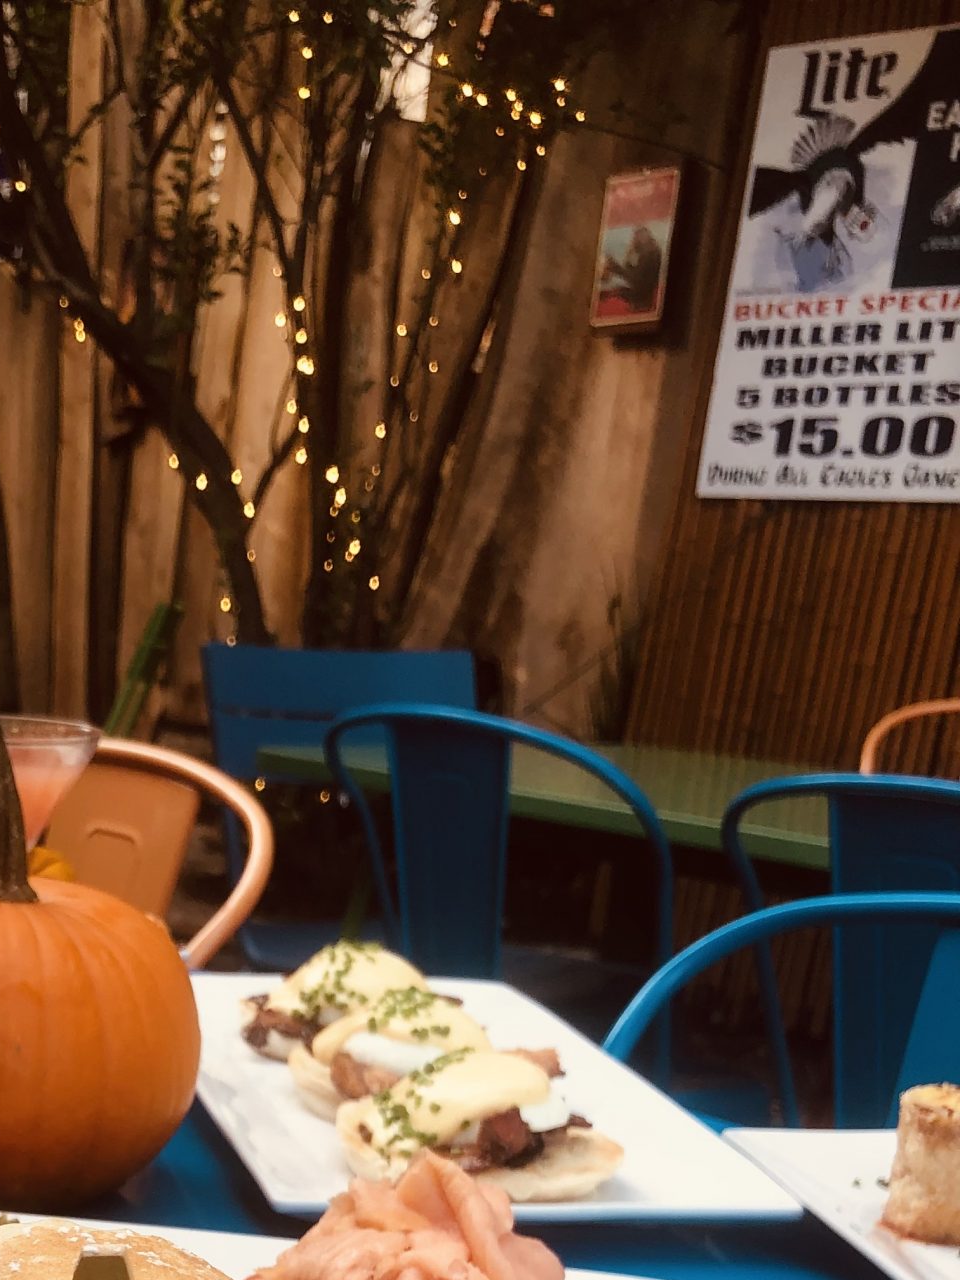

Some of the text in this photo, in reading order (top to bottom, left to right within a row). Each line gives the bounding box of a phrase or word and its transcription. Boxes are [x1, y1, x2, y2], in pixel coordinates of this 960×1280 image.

[795, 47, 898, 117] Lite
[734, 295, 849, 320] BUCKET
[737, 321, 881, 349] MILLER
[762, 350, 934, 377] BUCKET
[738, 382, 960, 408] 5 BOTTLES
[730, 415, 956, 459] $15.00
